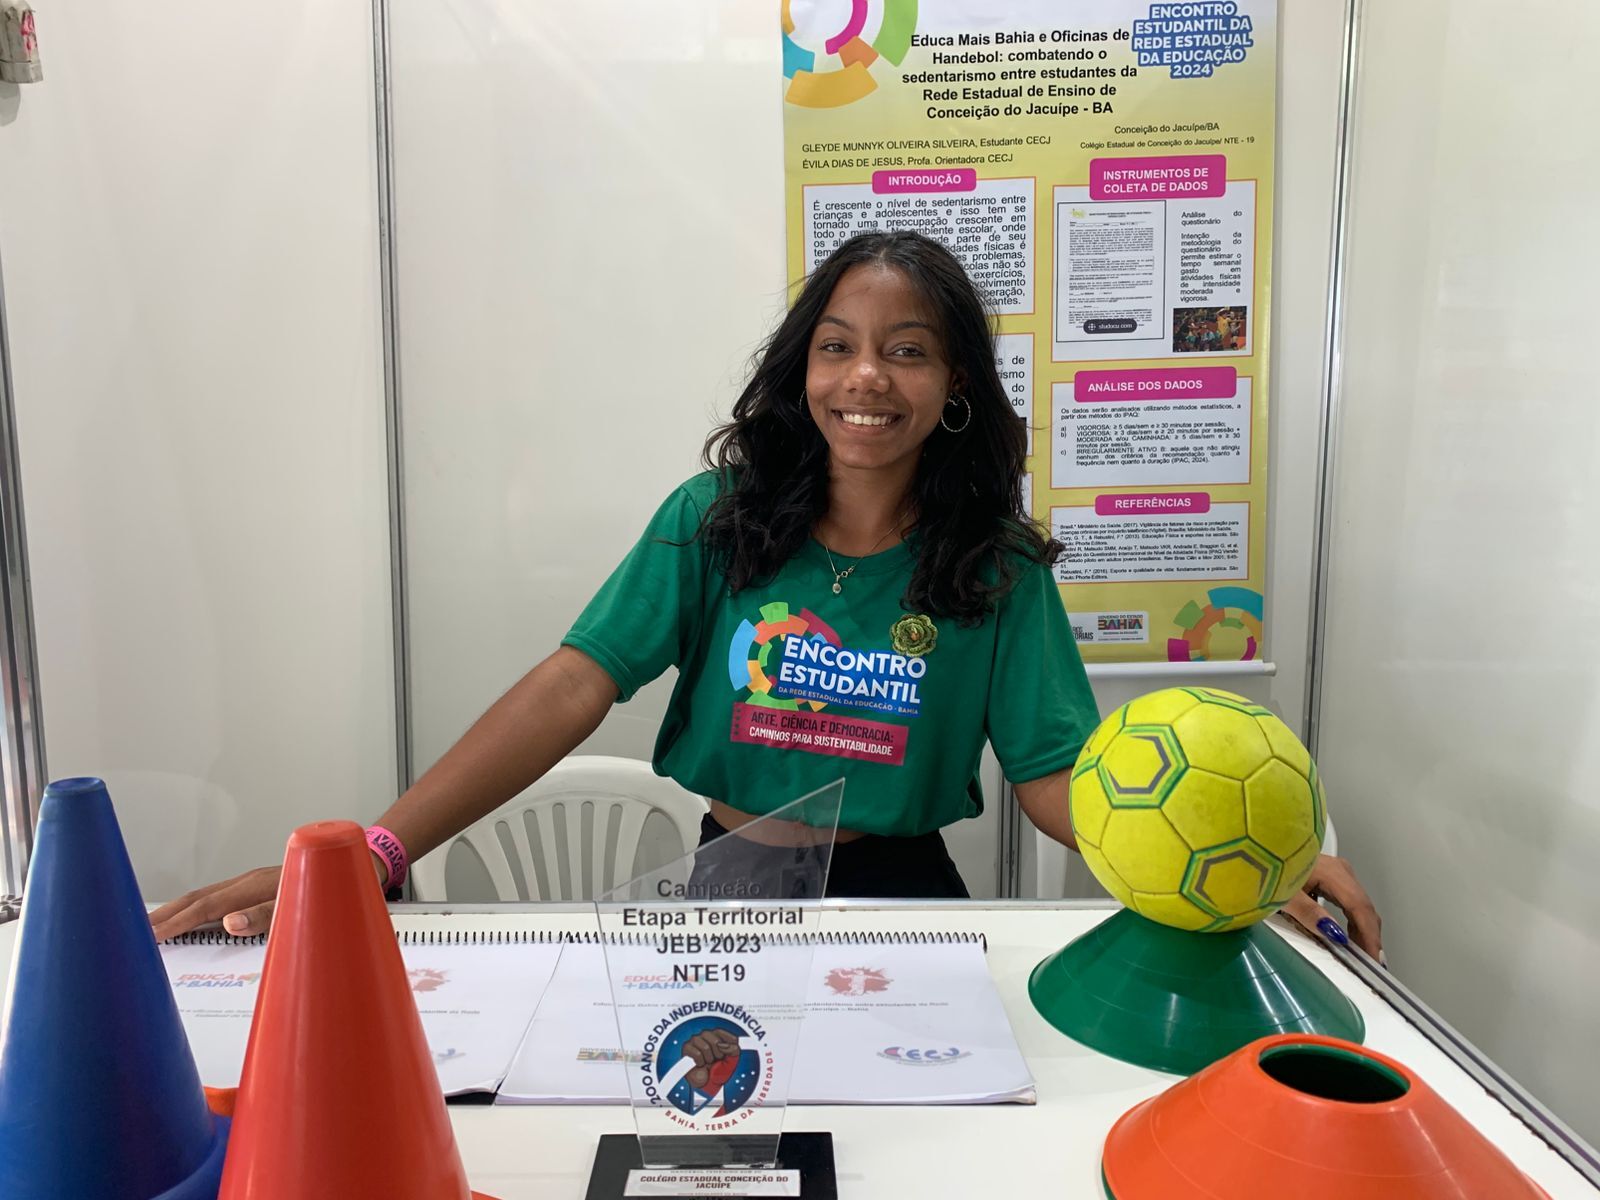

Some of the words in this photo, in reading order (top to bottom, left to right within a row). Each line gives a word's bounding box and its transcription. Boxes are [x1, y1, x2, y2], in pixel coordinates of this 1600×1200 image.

[1151, 3, 1235, 18] ENCONTRO
[1135, 19, 1227, 35] ESTUDANTIL
[1230, 17, 1250, 31] DA
[911, 34, 954, 47] Educa
[958, 33, 991, 46] Mais
[995, 31, 1035, 45] Bahia
[1039, 33, 1047, 43] e
[1051, 30, 1108, 43] Oficinas
[1112, 28, 1130, 41] de
[1134, 36, 1172, 50] REDE
[1175, 33, 1251, 48] ESTADUAL
[932, 51, 1004, 64] Handebol:
[1008, 49, 1094, 62] combatendo
[1098, 50, 1107, 59] o
[1140, 51, 1161, 64] DA
[1163, 47, 1245, 65] EDUCAÇÃO
[902, 70, 996, 84] sedentarismo
[1001, 68, 1036, 80] entre
[1040, 66, 1116, 79] estudantes
[1120, 65, 1138, 77] da
[1173, 64, 1211, 77] 2024
[923, 88, 958, 101] Rede
[962, 86, 1023, 100] Estadual
[1027, 85, 1044, 97] de
[1048, 84, 1096, 96] Ensino
[1099, 84, 1117, 95] de
[926, 104, 999, 120] Conceição
[1004, 104, 1022, 116] do
[1026, 102, 1079, 117] Jacuípe
[1092, 101, 1114, 114] BA
[1114, 125, 1159, 135] Conceição
[1159, 124, 1171, 133] do
[1172, 122, 1220, 134] Jacuípe/BA
[802, 143, 841, 153] GLEYDE
[843, 141, 884, 152] MUNNYK
[886, 140, 930, 150] OLIVEIRA
[932, 138, 978, 149] SILVEIRA,
[980, 136, 1023, 147] Estudante
[1026, 136, 1051, 146] CECJ
[1080, 141, 1105, 150] Colégio
[1106, 140, 1135, 149] Estadual
[1136, 140, 1146, 148] de
[1147, 139, 1182, 148] Conceição
[1184, 138, 1193, 146] do
[1223, 137, 1239, 145] NTE
[1247, 136, 1255, 144] 19
[802, 159, 830, 169] ÉVILA
[832, 159, 854, 169] DIAS
[856, 158, 870, 167] DE
[872, 157, 906, 167] JESUS,
[907, 156, 932, 166] Profa.
[934, 154, 985, 165] Orientadora
[987, 153, 1013, 163] CECJ
[888, 174, 962, 187] INTRODUÇÃO
[1103, 169, 1191, 180] INSTRUMENTOS
[1193, 168, 1209, 178] DE
[1103, 182, 1148, 194] COLETA
[1151, 182, 1166, 193] DE
[1169, 180, 1208, 191] DADOS
[813, 199, 821, 211] É
[825, 201, 872, 210] crescente
[876, 201, 883, 209] o
[887, 199, 911, 208] nível
[914, 198, 928, 208] de
[931, 196, 996, 207] sedentarismo
[1001, 195, 1027, 204] entre
[813, 210, 853, 222] crianças
[875, 207, 938, 218] adolescentes
[960, 206, 979, 215] isso
[987, 205, 1006, 214] tem
[1014, 205, 1026, 213] se
[813, 220, 850, 230] tornado
[857, 220, 879, 229] uma
[886, 217, 948, 230] preocupação
[955, 215, 1003, 225] crescente
[1011, 215, 1027, 223] em
[1181, 218, 1221, 226] questionário
[1181, 232, 1210, 240] Intenção
[1181, 239, 1221, 247] metodologia
[972, 251, 1025, 263] problemas.
[1180, 246, 1221, 254] questionário
[1180, 253, 1205, 261] permite
[1208, 252, 1233, 260] estimar
[1180, 260, 1202, 268] tempo
[1180, 267, 1199, 276] gasto
[973, 269, 1026, 280] exercícios,
[1180, 273, 1214, 281] atividades
[1088, 381, 1135, 393] ANÁLISE
[1137, 381, 1162, 391] DOS
[1164, 380, 1203, 390] DADOS
[1114, 497, 1192, 509] REFERÊNCIAS
[1097, 618, 1143, 630] BAHIA
[784, 636, 927, 679] ENCONTRO
[779, 662, 921, 704] ESTUDANTIL
[778, 686, 788, 694] DA
[789, 688, 807, 697] REDE
[807, 690, 842, 704] ESTADUAL
[854, 699, 893, 712] EDUCAÇÃO
[751, 711, 778, 727] ARTE,
[780, 713, 818, 731] CIÊNCIA
[819, 720, 826, 732] E
[828, 720, 894, 743] DEMOCRACIA:
[749, 726, 790, 742] CAMINHOS
[791, 731, 812, 745] PARA
[813, 735, 893, 756] SUSTENTABILIDADE
[657, 877, 762, 902] Campeão
[622, 908, 686, 930] Etapa
[694, 907, 803, 926] Territorial
[656, 935, 702, 955] JEB
[709, 935, 762, 954] 2023
[673, 964, 746, 982] NTE19
[653, 1017, 673, 1038] DA
[669, 1000, 766, 1042] INDEPENDÊNCIA
[641, 1034, 659, 1073] ANOS
[642, 1076, 662, 1105] 200
[664, 1110, 700, 1132] BAHIA,
[705, 1118, 738, 1132] TERRA
[740, 1108, 754, 1120] DA
[755, 1051, 774, 1107] LIBERDADE
[640, 1175, 677, 1183] COLÉGIO
[679, 1175, 722, 1183] ESTADUAL
[724, 1175, 774, 1184] CONCEIÇÃO
[695, 1181, 732, 1189] JACUÍPE
